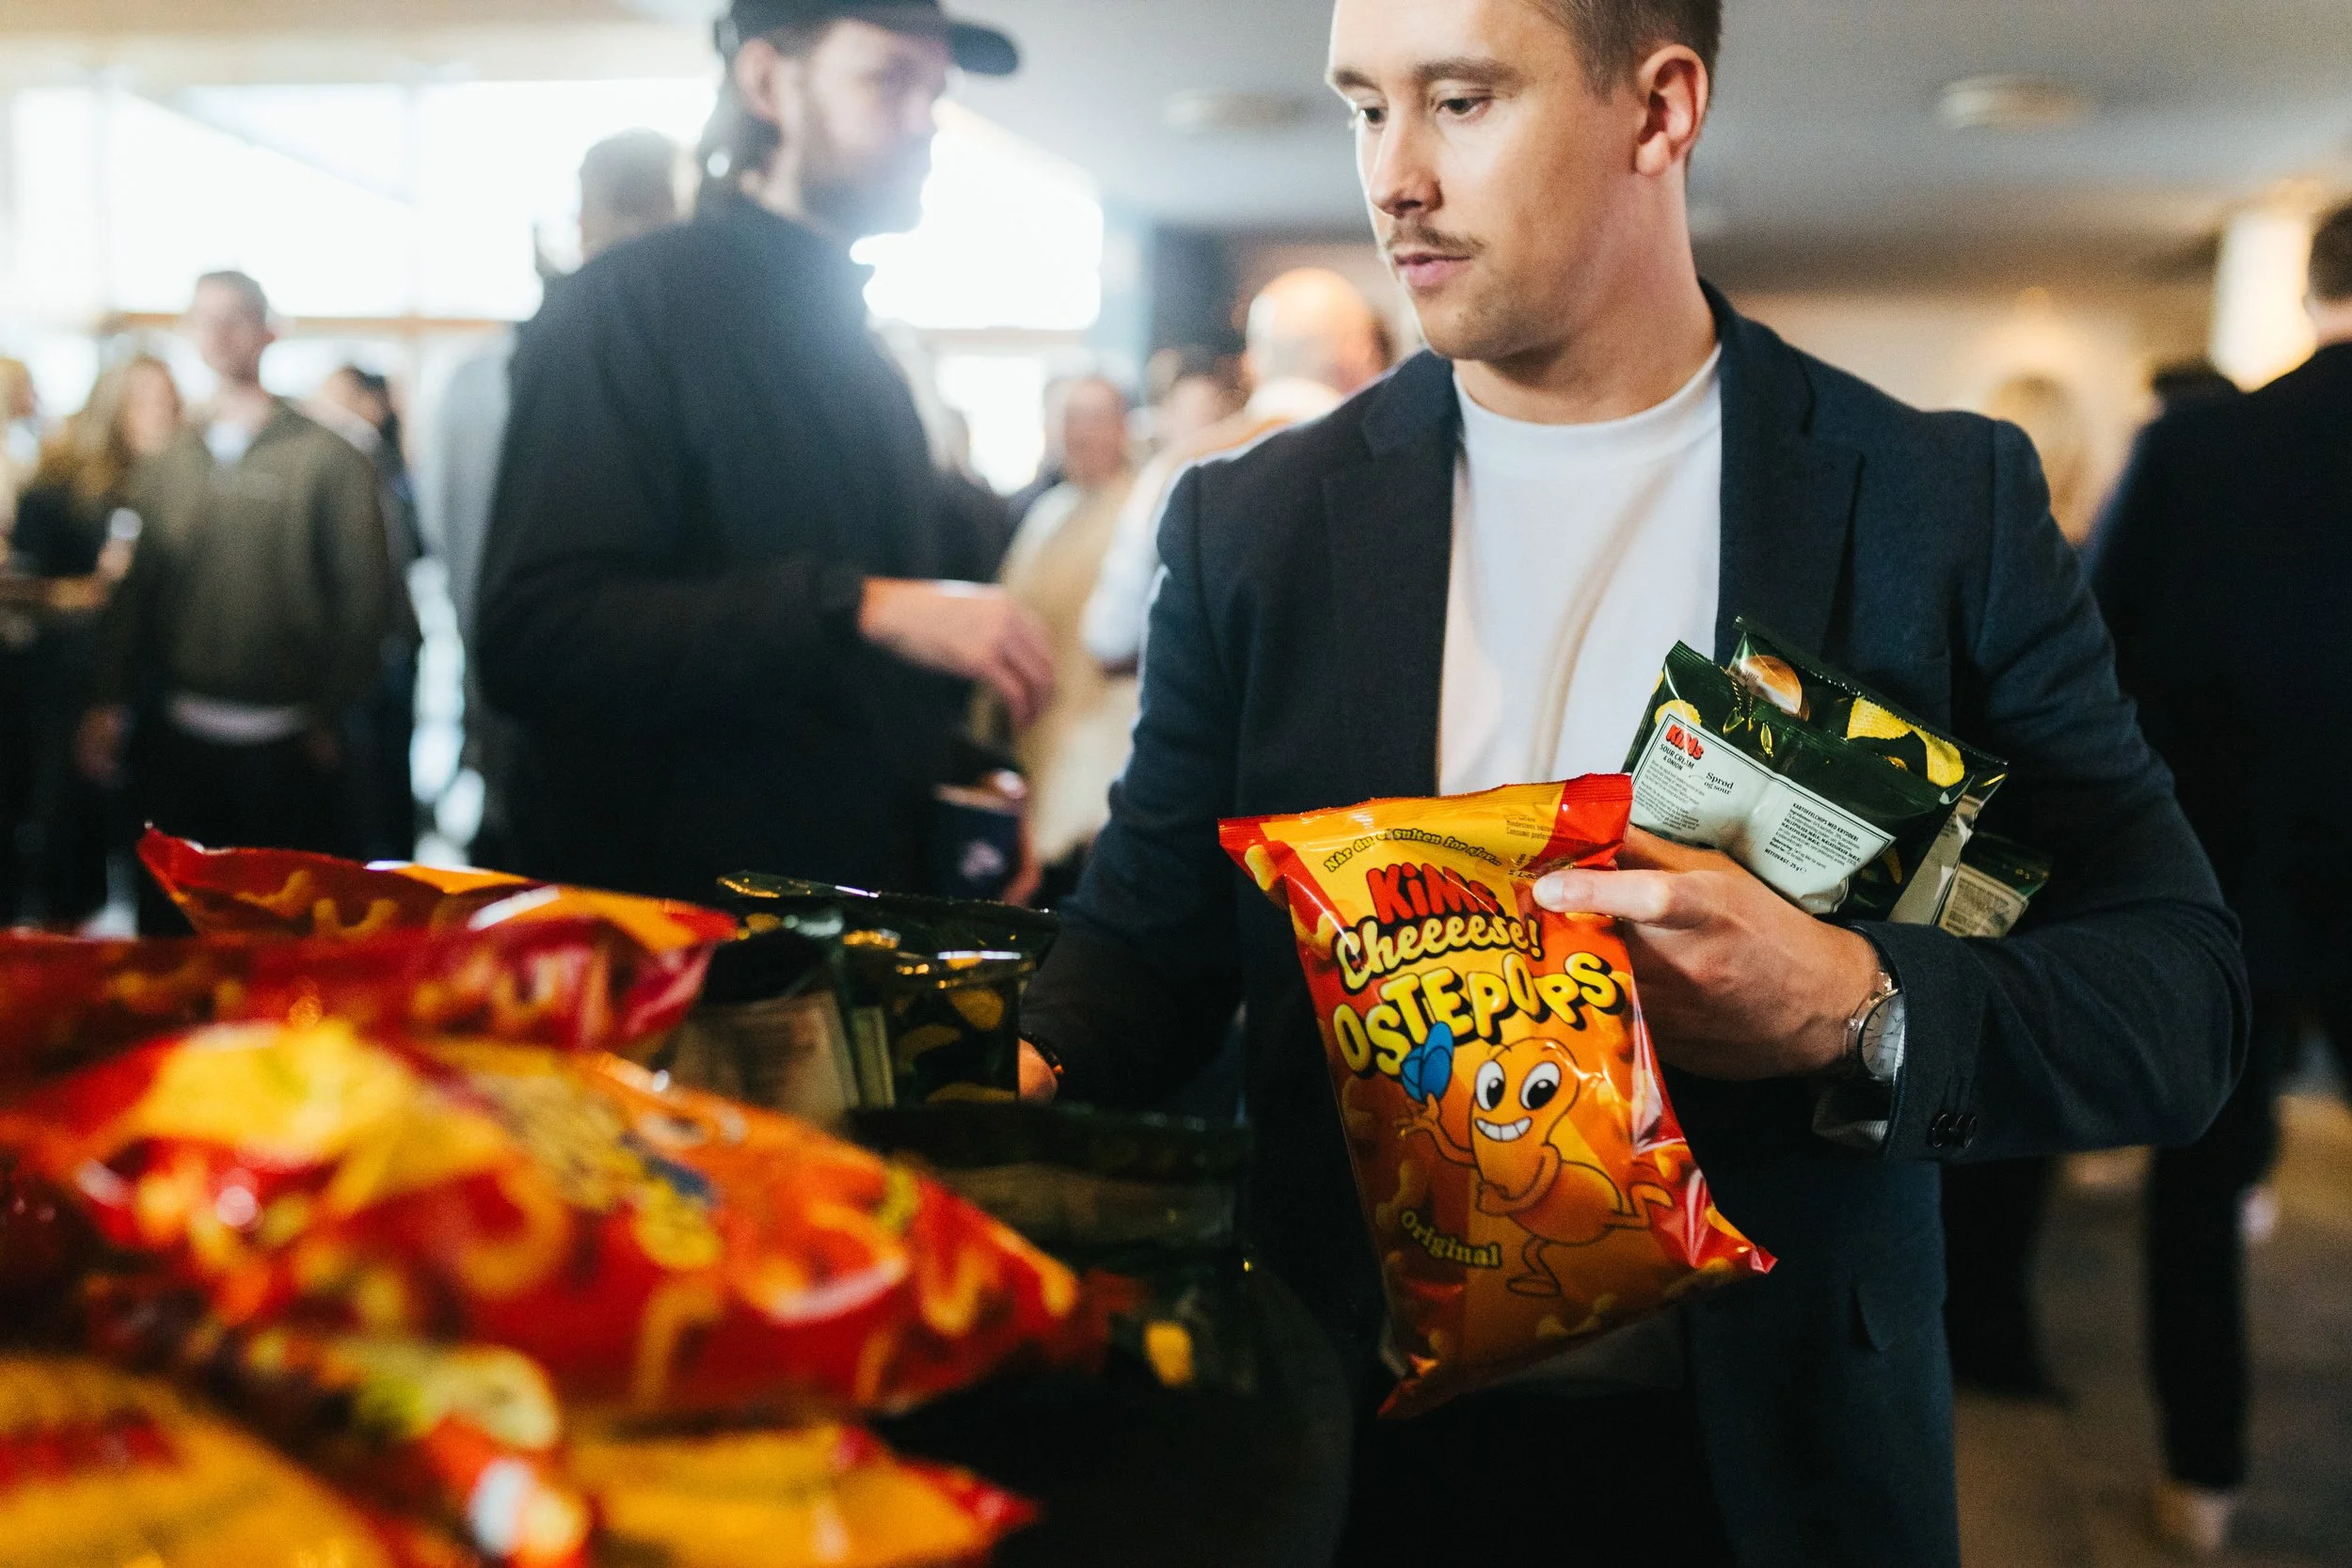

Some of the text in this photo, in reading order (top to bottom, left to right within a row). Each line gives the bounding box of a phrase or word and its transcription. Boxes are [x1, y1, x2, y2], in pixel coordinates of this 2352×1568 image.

[1660, 743, 1675, 754] SOUR
[1666, 724, 1704, 760] KiMs
[1666, 757, 1683, 771] ONION
[1706, 772, 1734, 789] Sprød
[1713, 784, 1732, 795] sour
[1827, 821, 1837, 830] MED
[1324, 847, 1353, 872] Når
[1353, 835, 1375, 854] du
[1392, 829, 1442, 845] sulten
[1443, 835, 1468, 851] for
[1366, 862, 1499, 925] KiMs
[1334, 914, 1543, 991] Cheeeese!
[1333, 952, 1622, 1076] OSTEPOPS
[1401, 1210, 1501, 1266] Original
